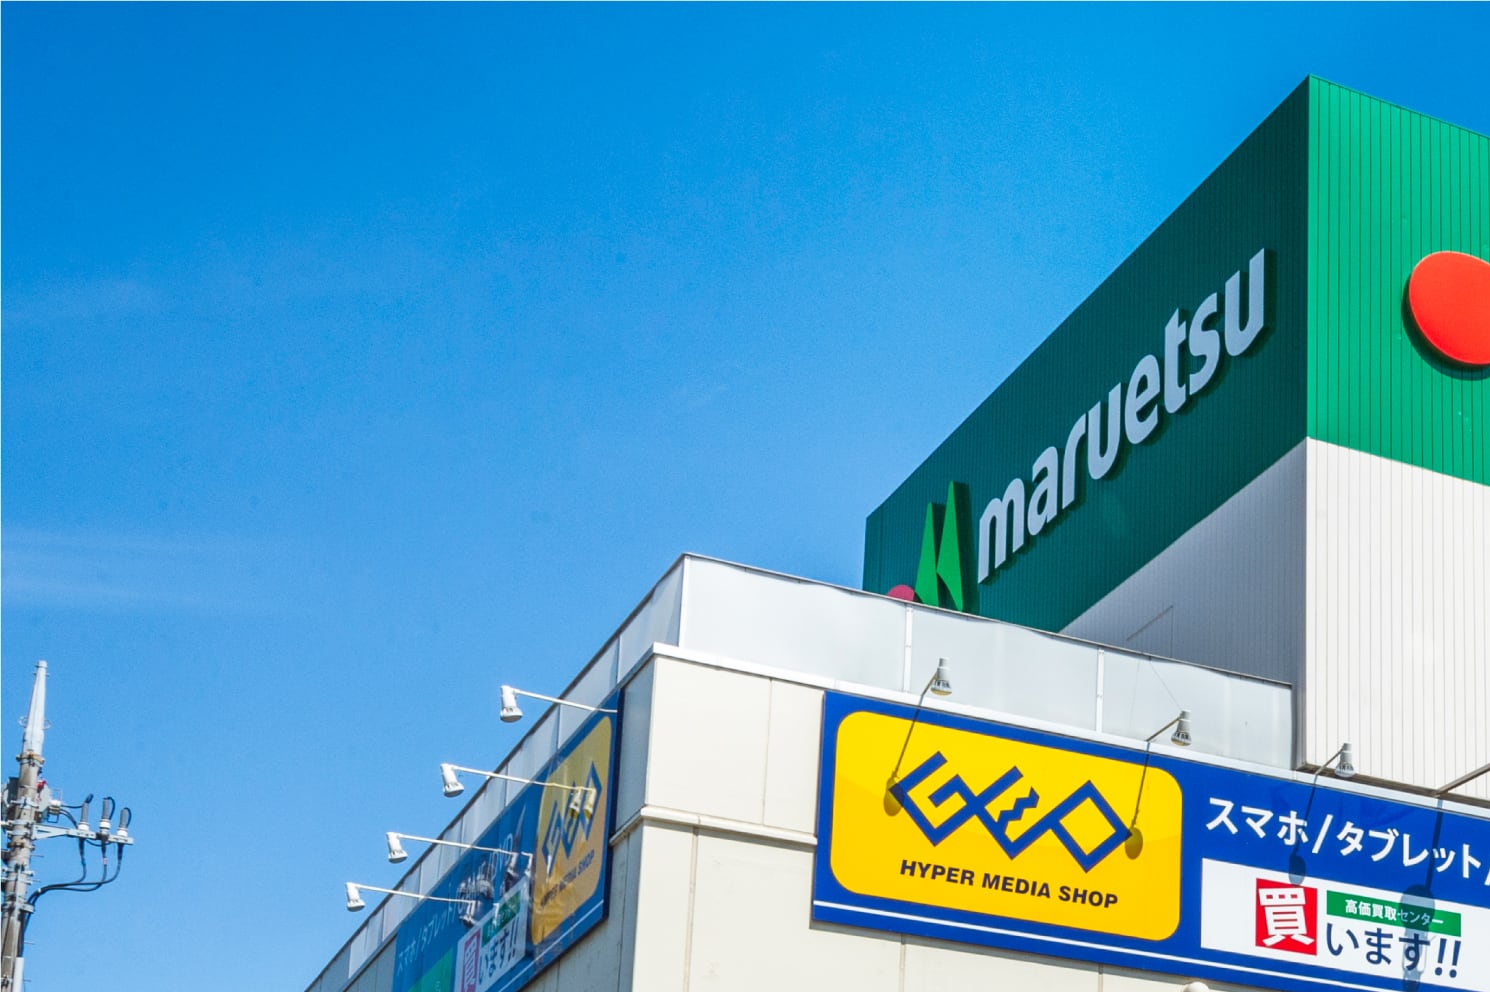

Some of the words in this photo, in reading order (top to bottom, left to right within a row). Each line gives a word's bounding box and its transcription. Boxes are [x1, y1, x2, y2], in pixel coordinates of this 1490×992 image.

[977, 247, 1268, 584] maruetsu
[888, 751, 1133, 874] GEO
[900, 859, 975, 886] HYPER
[981, 873, 1051, 899] MEDIA
[1058, 886, 1119, 909] SHOP
[1344, 898, 1444, 926] 高価買取センター
